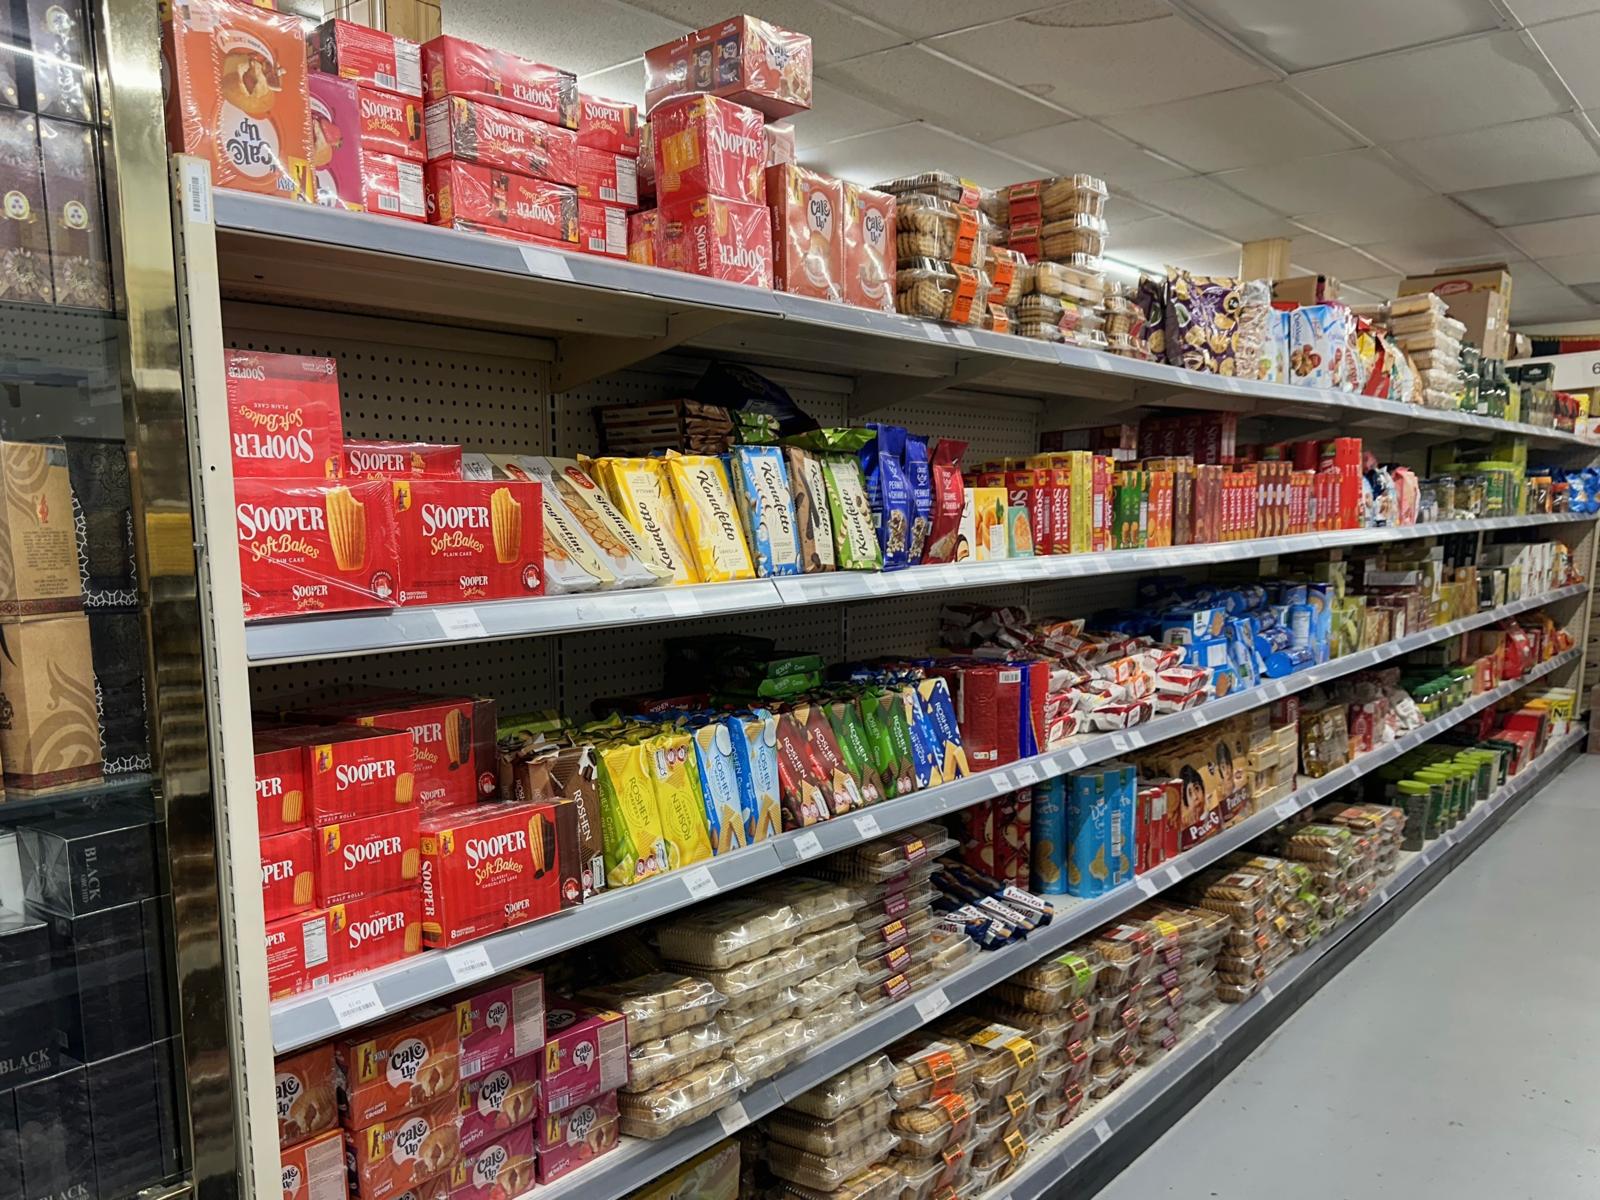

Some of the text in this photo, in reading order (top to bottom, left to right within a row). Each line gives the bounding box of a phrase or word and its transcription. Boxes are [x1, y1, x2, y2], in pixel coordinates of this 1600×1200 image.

[362, 98, 402, 122] SOOPER
[513, 84, 552, 109] SOOPER
[585, 102, 620, 122] SOOPER
[483, 118, 524, 143] SOOPER
[711, 125, 758, 158] SOOPER
[226, 138, 272, 165] Cake
[516, 201, 556, 226] SOOPER
[810, 200, 830, 217] Cake
[866, 216, 884, 232] Cake
[694, 225, 707, 270] SOOPER
[720, 245, 765, 272] SOOPER
[229, 366, 266, 382] SOOPER
[240, 405, 303, 432] Soft Bakes
[234, 429, 314, 464] SOOPER
[350, 450, 404, 476] SOOPER
[696, 470, 735, 541] Konafetto
[761, 461, 790, 534] Konafetto
[236, 503, 325, 540] SOOPER
[422, 504, 490, 536] SOOPER
[1035, 488, 1044, 541] SOOPER
[1053, 488, 1062, 541] SOOPER
[251, 534, 320, 562] Soft Bakes
[430, 530, 485, 556] Soft Bakes
[292, 585, 328, 600] SOOPER
[400, 590, 406, 600] 8
[460, 576, 488, 590] SOOPER
[935, 702, 952, 739] ROSHEN
[814, 727, 840, 767] ROSHEN
[848, 722, 868, 762] ROSHEN
[758, 746, 771, 791] ROSHEN
[784, 736, 808, 778] ROSHEN
[336, 760, 396, 791] SOOPER
[714, 754, 732, 802] ROSHEN
[420, 788, 446, 804] SOOPER
[630, 776, 650, 826] ROSHEN
[573, 788, 592, 842] ROSHEN
[672, 793, 692, 840] ROSHEN
[343, 836, 402, 871] SOOPER
[465, 830, 527, 870] SOOPER
[84, 846, 101, 900] BLACK
[475, 857, 524, 886] Soft Bakes
[422, 860, 434, 917] SOOPER
[504, 898, 530, 918] SOOPER
[349, 912, 405, 949] SOOPER
[450, 930, 456, 939] 8
[488, 1005, 506, 1021] Cake
[0, 1049, 50, 1075] BLACK
[391, 1042, 426, 1071] Cake
[576, 1044, 592, 1058] Cake
[400, 1066, 416, 1080] Up
[482, 1073, 510, 1101] Cake
[396, 1120, 427, 1148] Cake
[570, 1108, 596, 1132] Cake
[404, 1142, 418, 1156] Up
[477, 1148, 505, 1174] Cake
